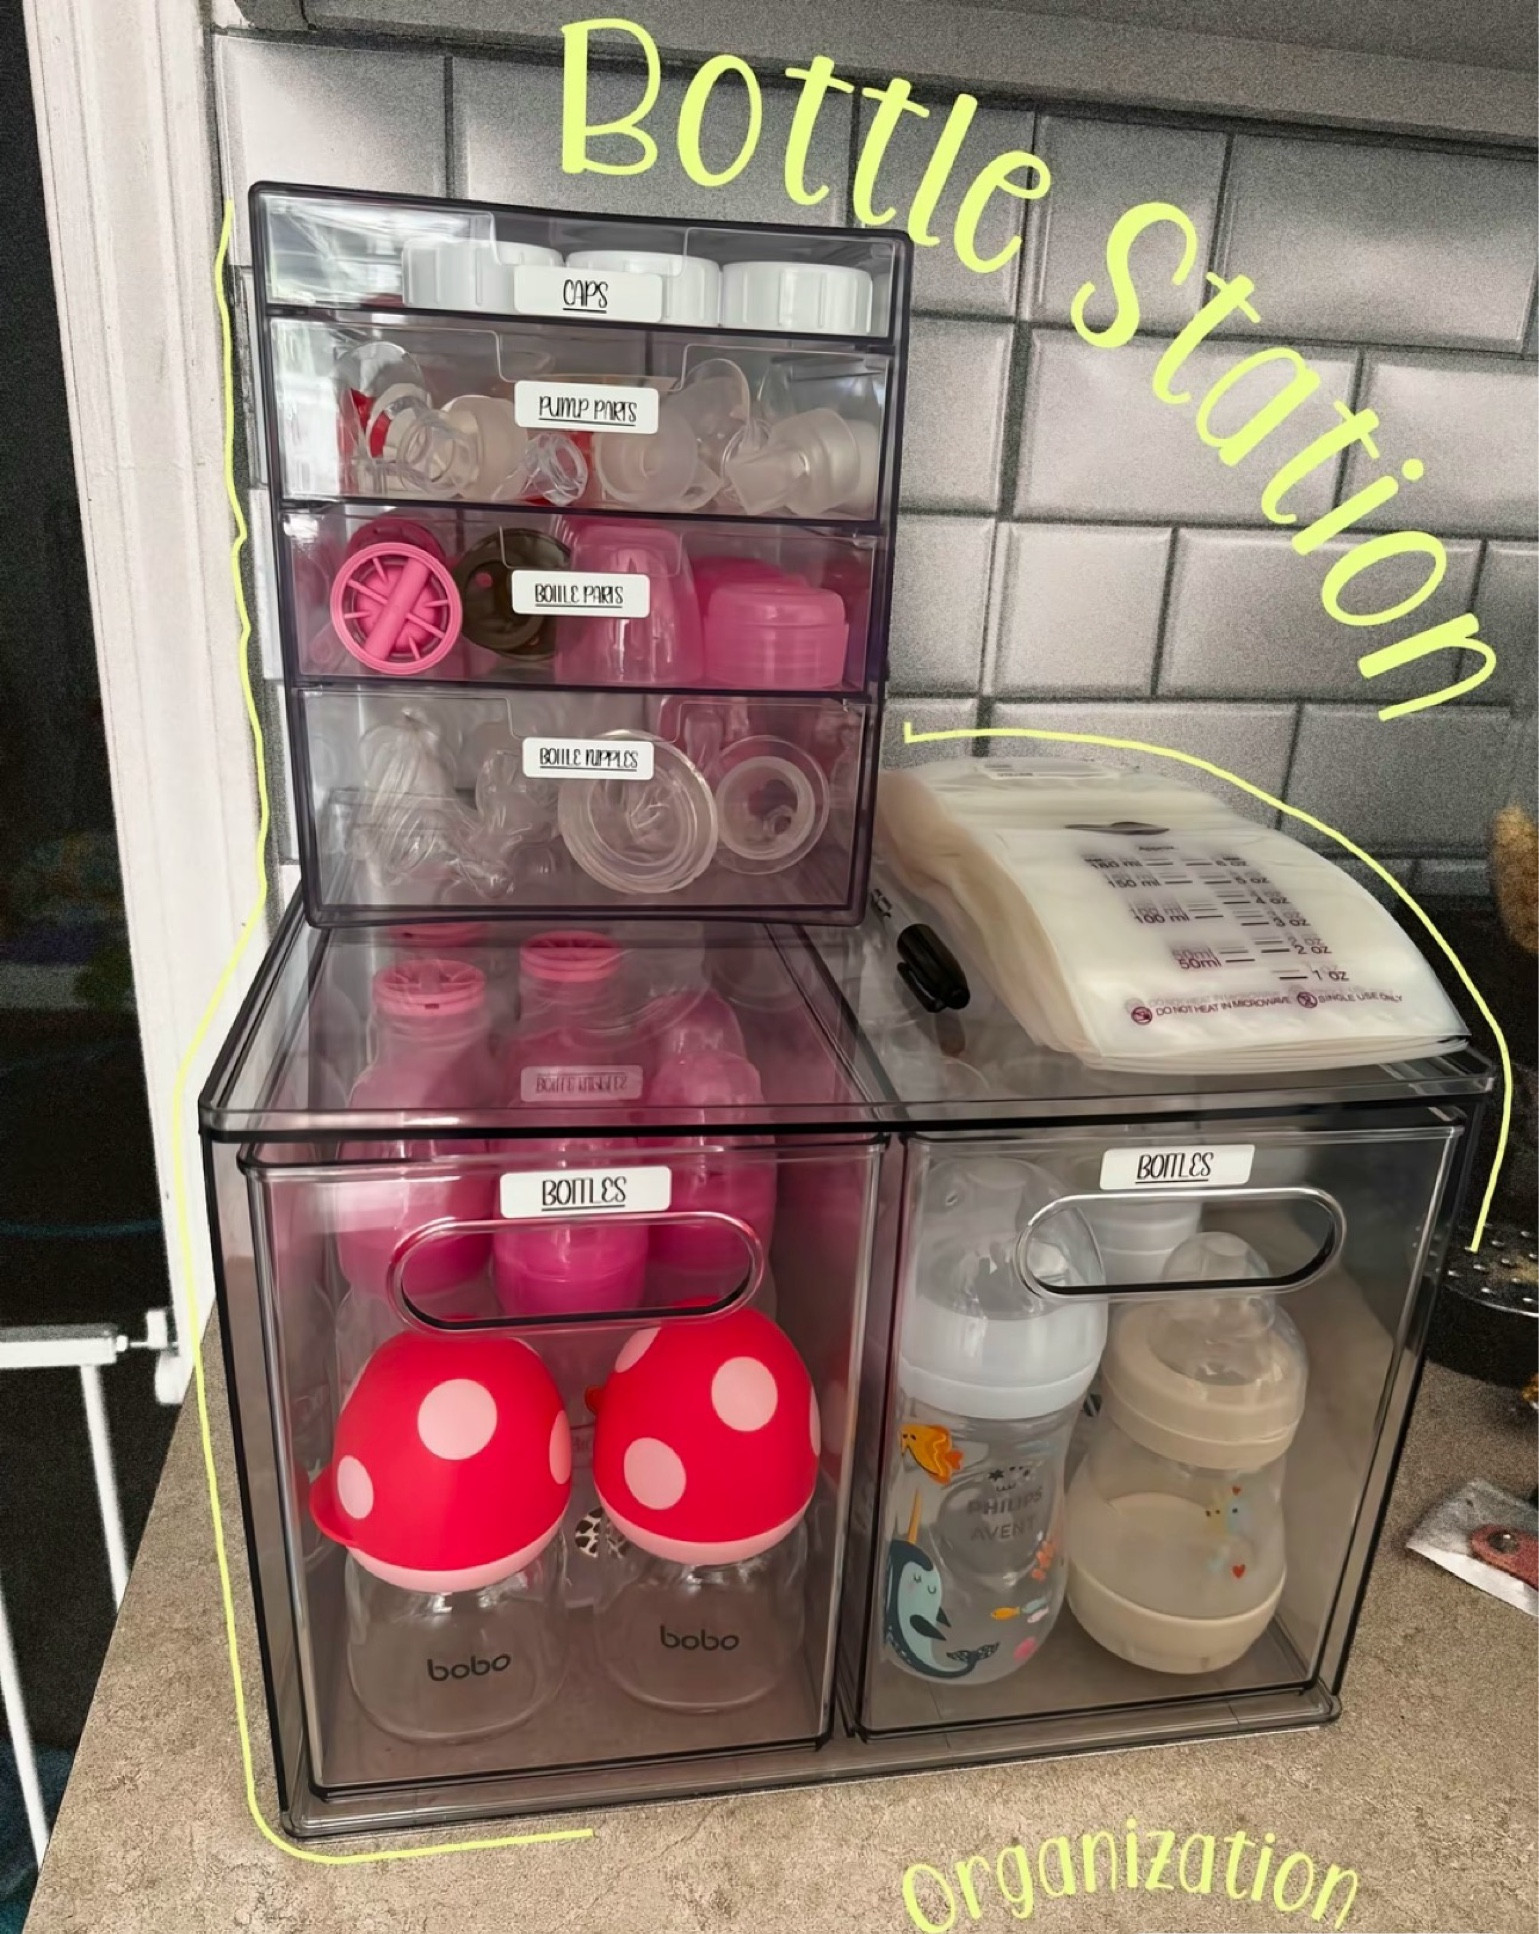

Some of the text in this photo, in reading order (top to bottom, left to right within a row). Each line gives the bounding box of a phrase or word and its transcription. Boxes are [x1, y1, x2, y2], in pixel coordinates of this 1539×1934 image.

[563, 279, 609, 308] CAPS
[539, 396, 637, 422] PUMP PARTS
[535, 583, 624, 604] BOTTLE PARTS
[540, 747, 638, 768] BOTTLE NIPPLES
[1141, 877, 1161, 886] ml
[1134, 912, 1190, 923] 100 ml
[1274, 917, 1311, 927] 3 oz
[1294, 944, 1332, 954] 2 oz
[1312, 970, 1349, 981] 1 oz
[1156, 1006, 1172, 1016] DO
[1173, 1005, 1193, 1014] NOT
[1194, 1003, 1218, 1013] HEAT
[1137, 1152, 1214, 1179] BOTTLES
[542, 1176, 627, 1206] BOTTLES
[660, 1625, 740, 1651] bobo
[427, 1653, 511, 1682] bobo
